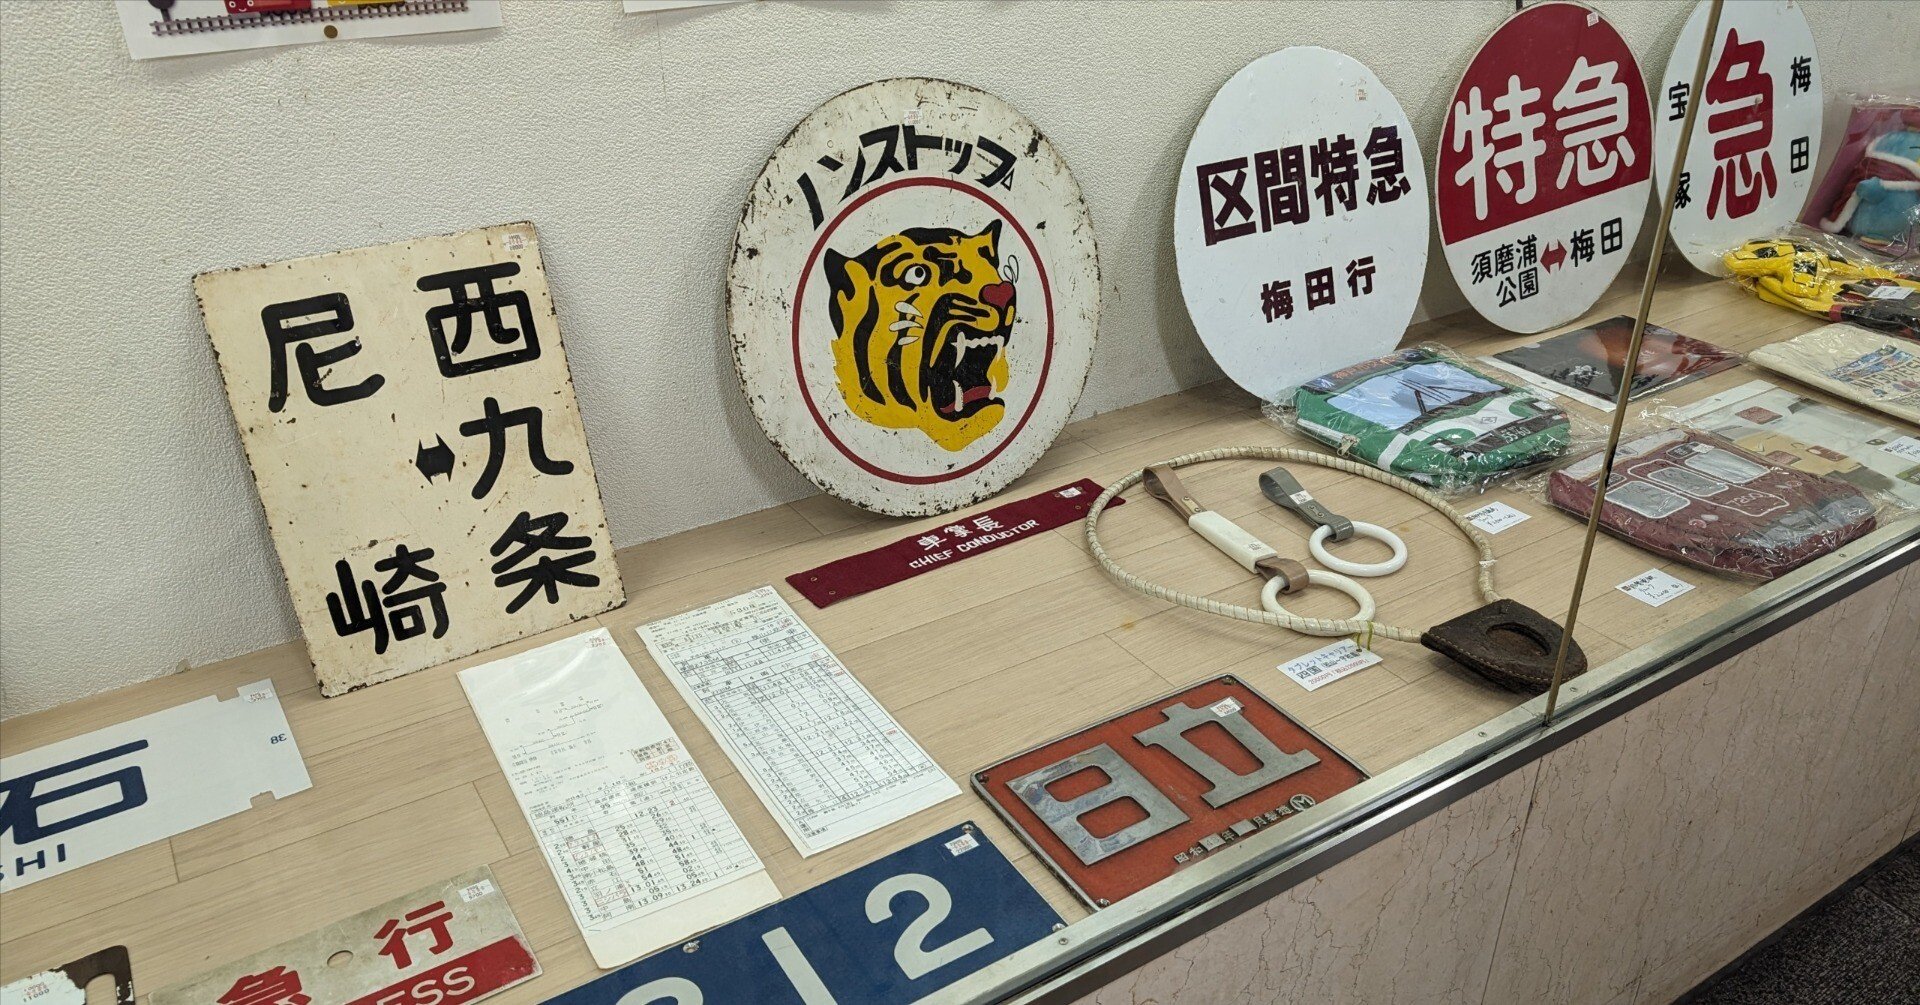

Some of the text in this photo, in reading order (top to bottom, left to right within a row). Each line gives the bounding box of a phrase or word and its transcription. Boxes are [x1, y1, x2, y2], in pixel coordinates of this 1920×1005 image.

[1453, 55, 1637, 221] 特急
[1706, 27, 1777, 221] 急
[1790, 56, 1812, 174] 梅田
[797, 124, 1018, 231] ノンストップ
[1196, 125, 1411, 246] 区間特急
[1261, 256, 1377, 323] 梅田行
[1497, 265, 1540, 307] 公園
[1570, 216, 1624, 269] 梅田
[261, 292, 448, 655] 尼崎
[417, 261, 600, 614] 西九条
[909, 519, 1039, 569] CHIEF CONDUCTOR
[1005, 700, 1321, 867] 日立
[616, 872, 996, 1005] 12
